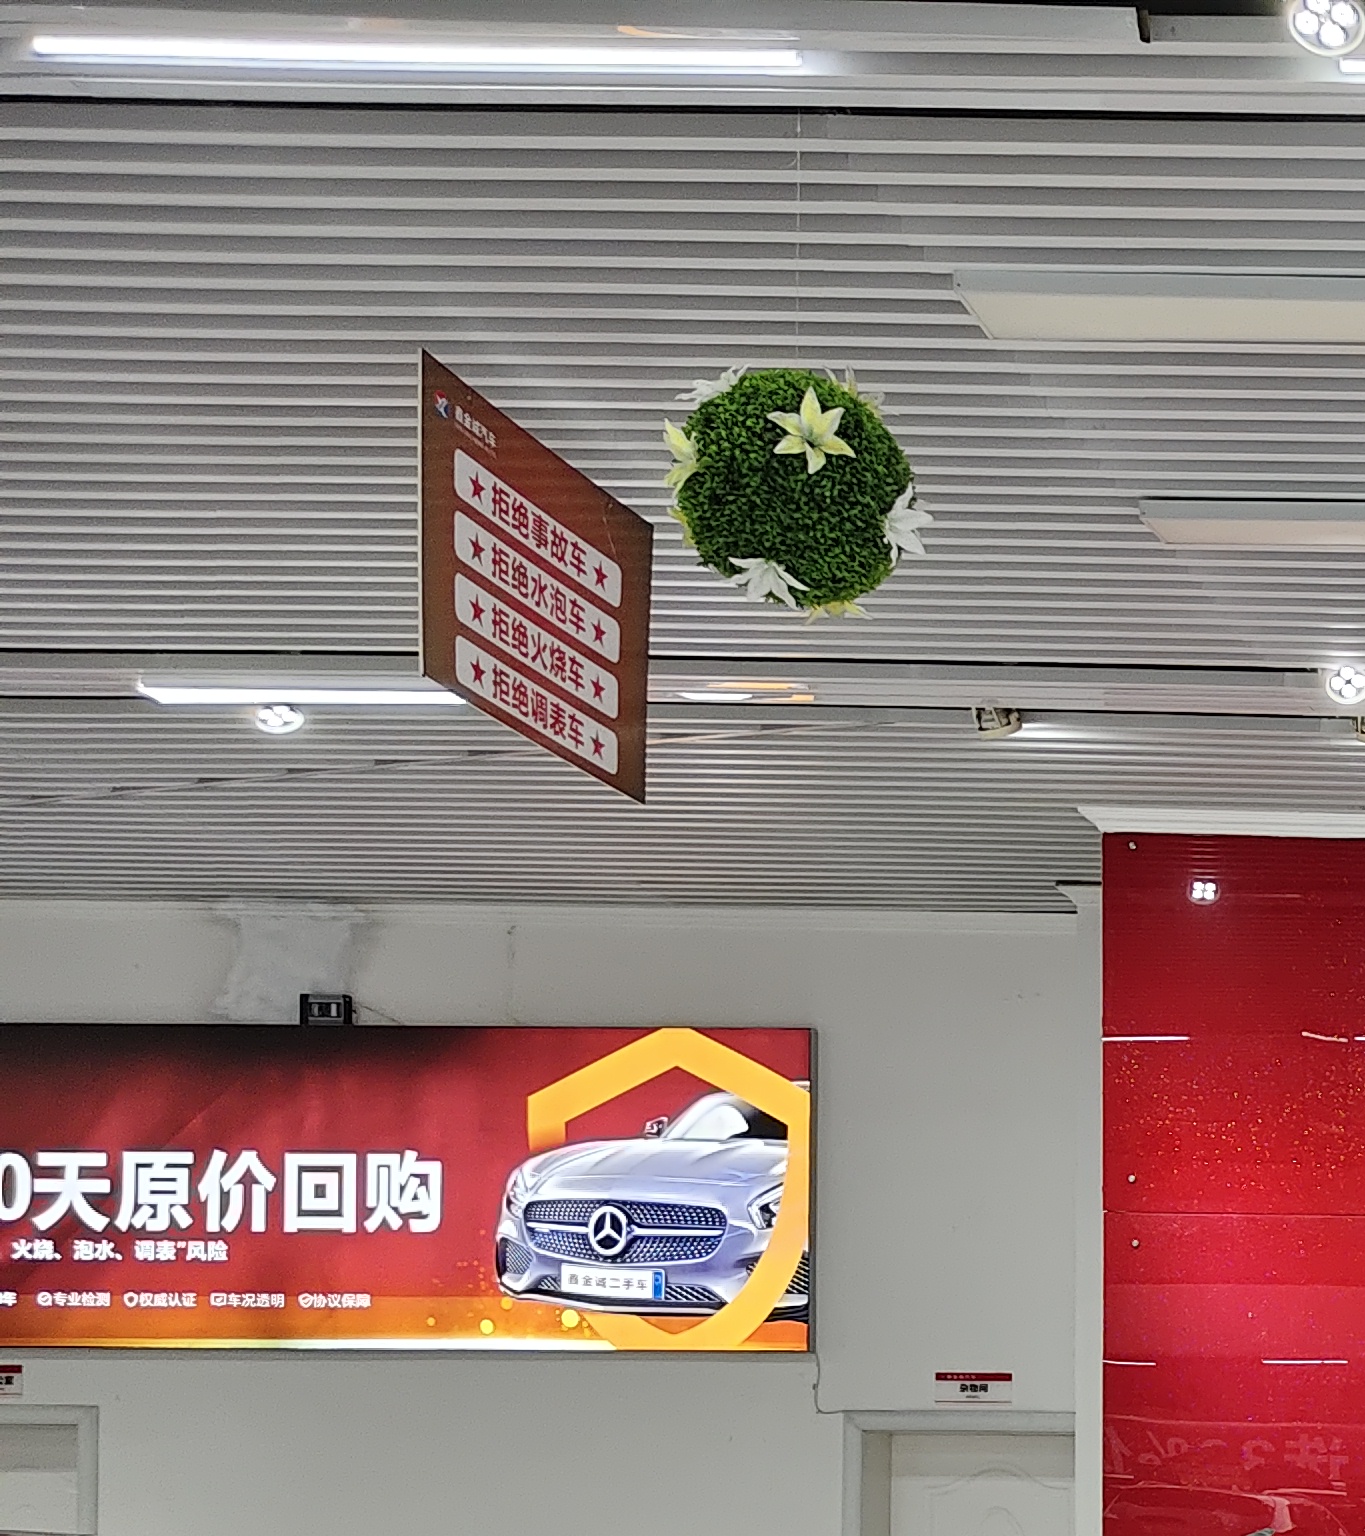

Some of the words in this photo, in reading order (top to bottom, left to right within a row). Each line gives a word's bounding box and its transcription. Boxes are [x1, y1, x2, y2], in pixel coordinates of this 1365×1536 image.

[491, 481, 588, 577] 拒绝事故车
[491, 542, 587, 635] 拒绝水泡车
[491, 602, 586, 692] 拒绝火烧车
[492, 663, 585, 749] 拒绝调表车
[228, 1292, 285, 1308] 车况透明
